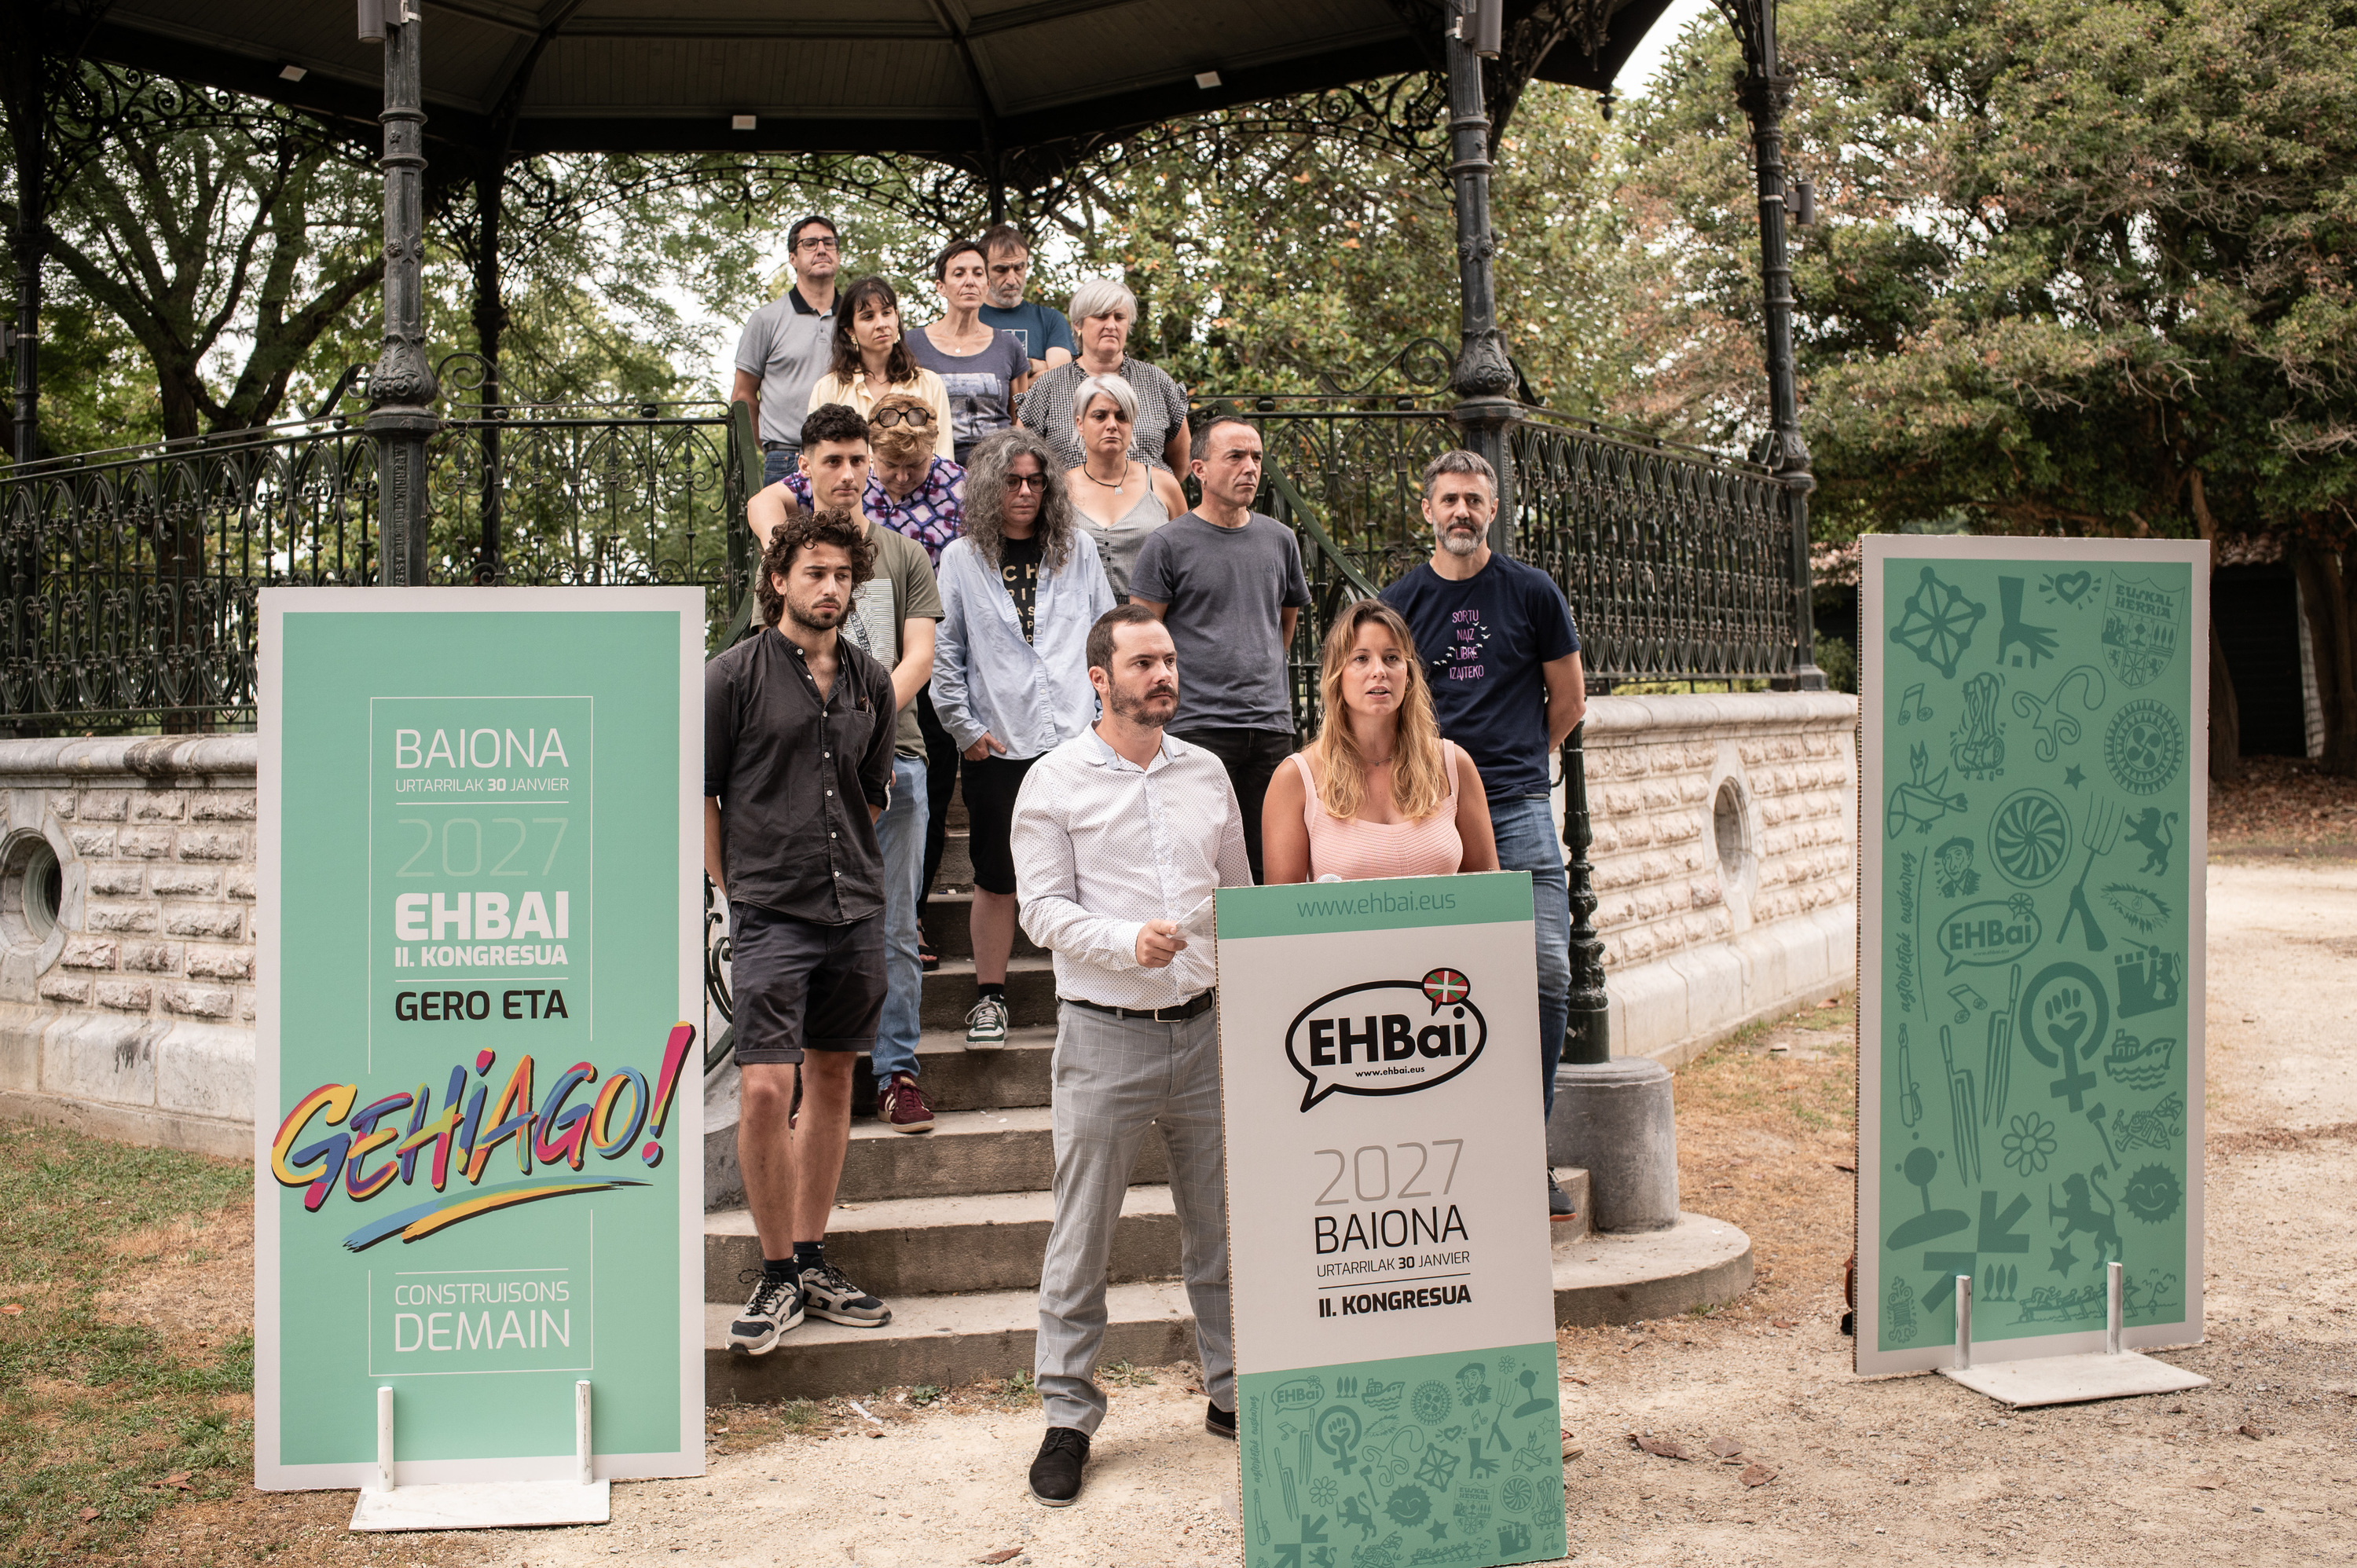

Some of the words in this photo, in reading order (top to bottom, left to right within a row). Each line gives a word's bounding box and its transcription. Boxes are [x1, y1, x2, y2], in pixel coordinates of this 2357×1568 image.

[2116, 584, 2174, 607] EUSKAL
[1453, 610, 1479, 624] SORTU
[1457, 628, 1474, 643] NAIZ
[1456, 647, 1479, 661] LIBRE
[1450, 665, 1484, 681] IZAITEKO
[396, 728, 569, 768] BAIONA
[396, 779, 483, 792] URTARRILAK
[488, 779, 506, 791] 30
[511, 778, 569, 791] JANVIER
[396, 818, 568, 877] 2027
[1897, 850, 1917, 924] euskaraz
[395, 891, 569, 940] EHBAI
[1297, 891, 1456, 917] www.ehbai.eus
[1949, 914, 2032, 951] EHBai
[395, 947, 414, 967] II.
[421, 944, 569, 967] KONGRESUA
[396, 991, 489, 1021] GERO
[504, 990, 568, 1019] ETA
[1309, 1006, 1467, 1067] EHBai
[1355, 1066, 1424, 1077] www.ehbai.eus
[1314, 1138, 1464, 1207] 2027
[1314, 1204, 1469, 1255] BAIONA
[1318, 1258, 1395, 1277] URTARRILAK
[1399, 1256, 1414, 1269] 30
[1419, 1251, 1469, 1267] JANVIER
[395, 1281, 569, 1305] CONSTRUISONS
[1319, 1299, 1336, 1317] II.
[1342, 1284, 1472, 1316] KONGRESUA
[395, 1309, 569, 1351] DEMAIN
[1277, 1386, 1320, 1403] EHBai
